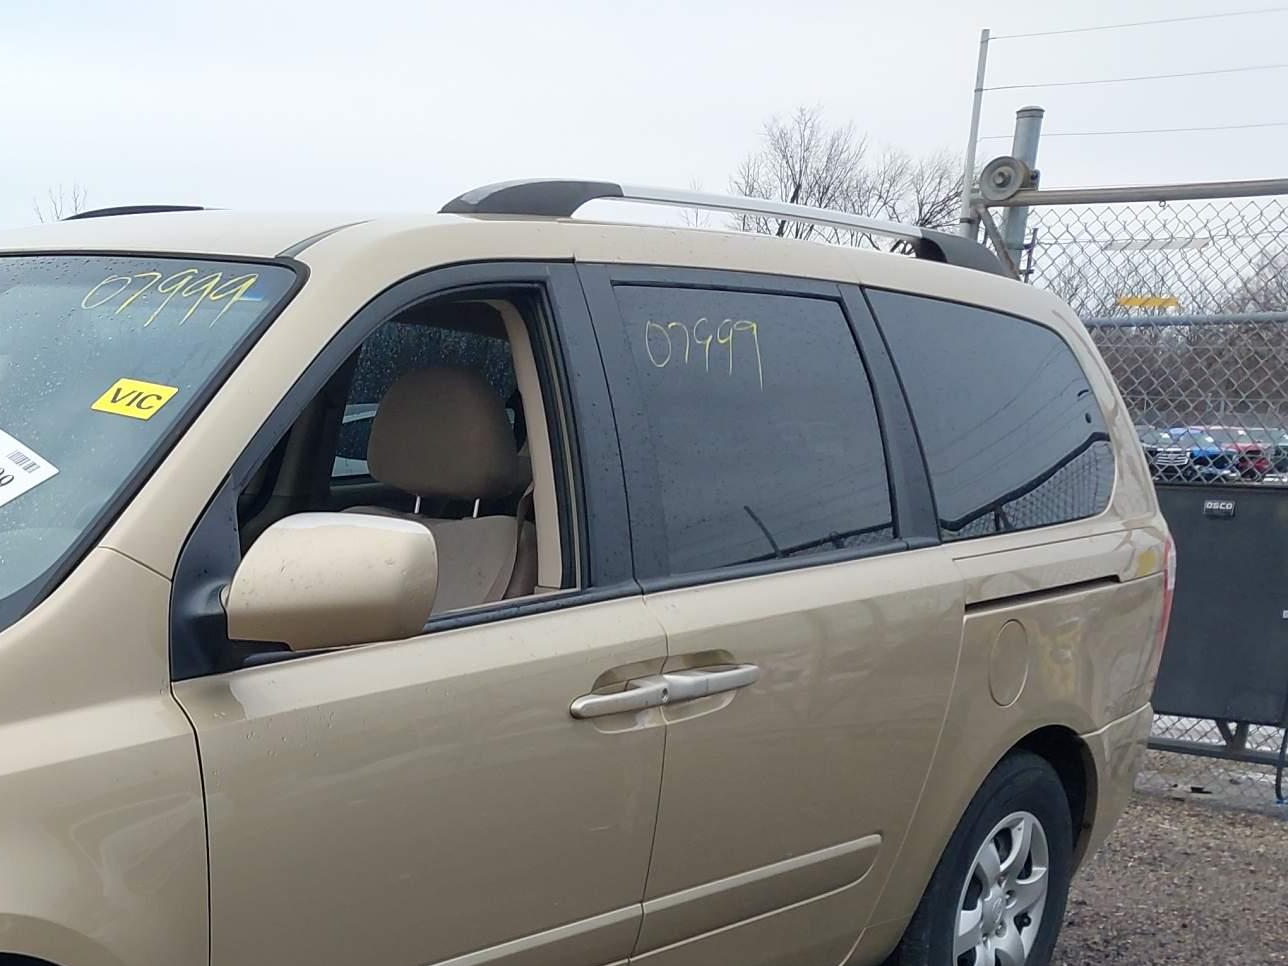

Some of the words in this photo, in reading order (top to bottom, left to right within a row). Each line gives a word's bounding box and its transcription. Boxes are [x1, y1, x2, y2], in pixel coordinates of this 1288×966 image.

[80, 268, 259, 328] 07999
[645, 317, 763, 392] 07999
[110, 387, 163, 411] VIC
